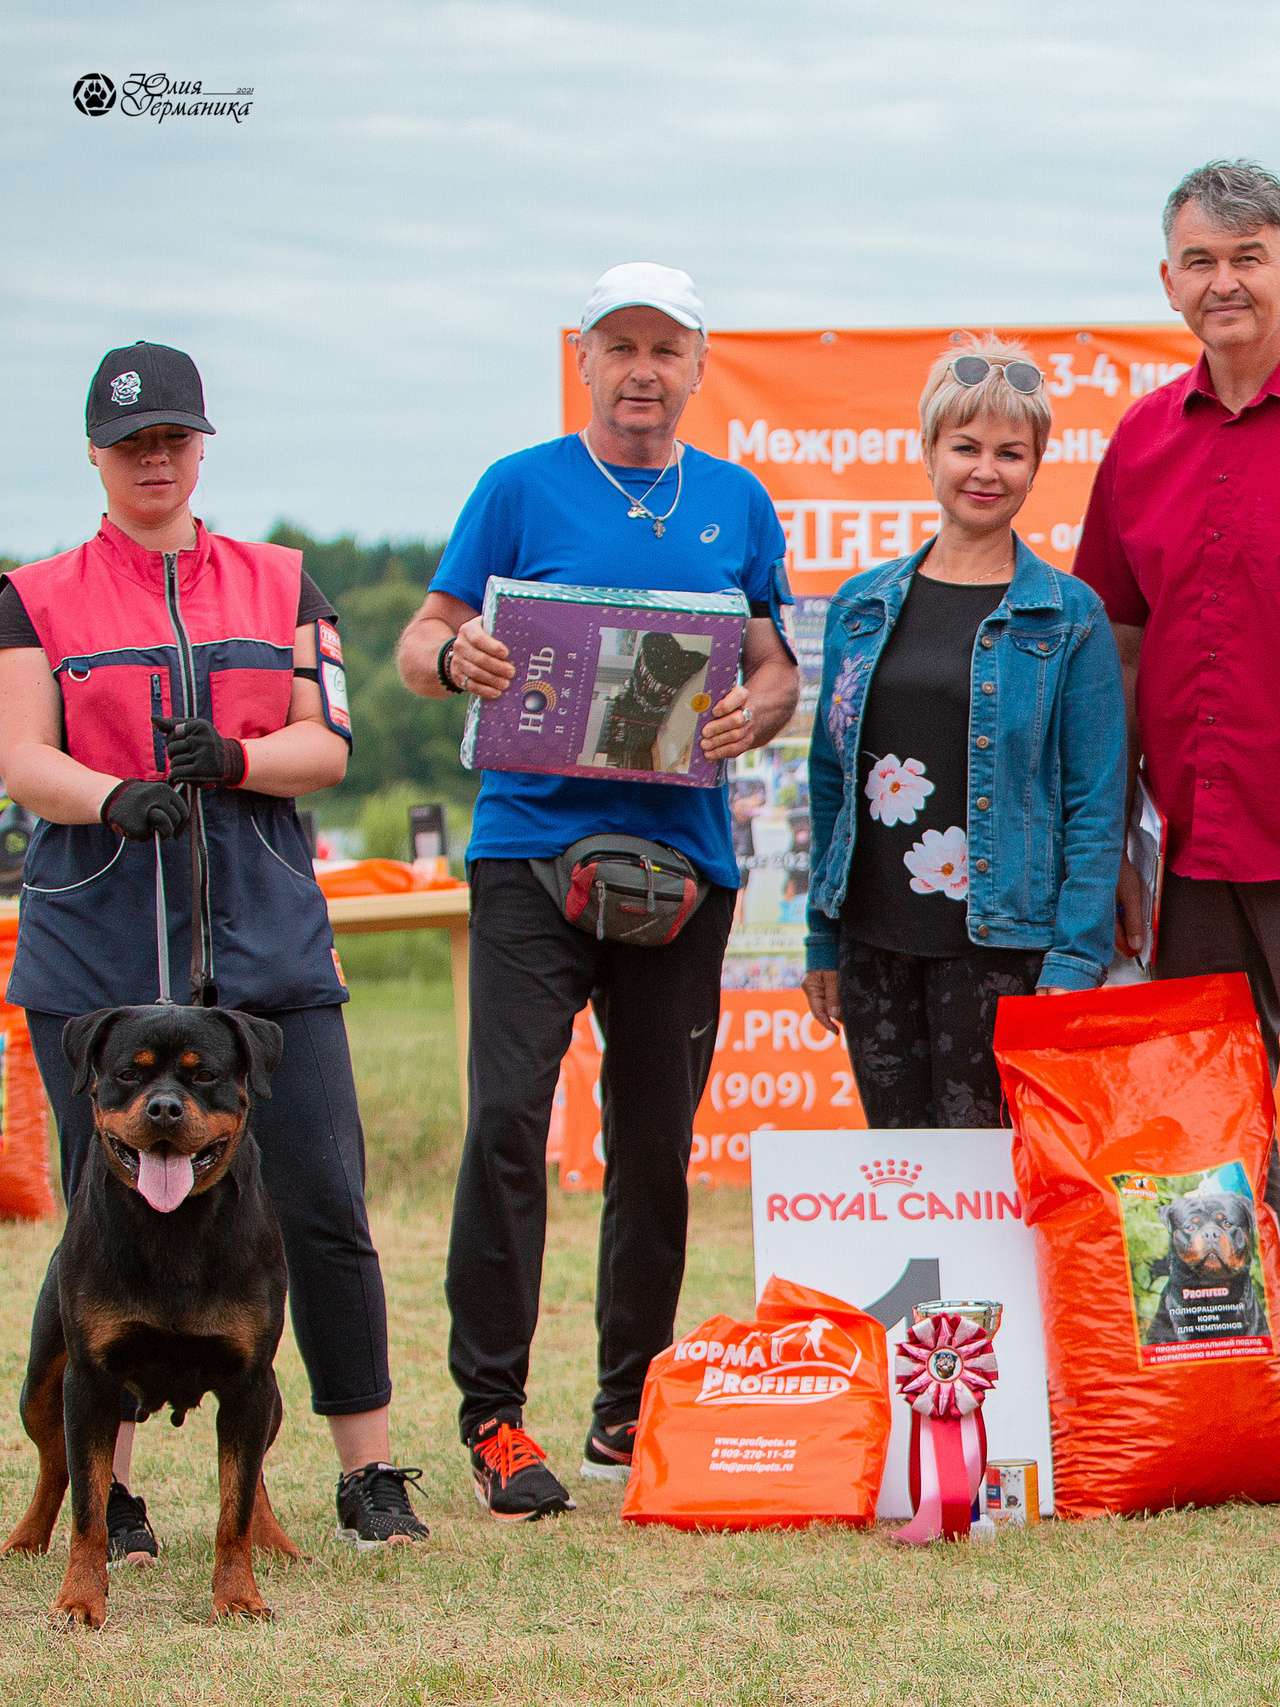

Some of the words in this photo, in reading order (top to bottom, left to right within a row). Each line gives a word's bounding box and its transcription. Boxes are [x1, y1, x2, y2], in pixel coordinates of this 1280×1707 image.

[1049, 353, 1120, 397] 3-4
[710, 1070, 816, 1113] (909)
[829, 1070, 856, 1107] 2
[766, 1192, 888, 1222] ROYAL
[897, 1190, 1022, 1221] CANIN
[1177, 1326, 1194, 1335] ДЛЯ
[1195, 1321, 1243, 1333] ЧЕМПИОНОВ
[1197, 1314, 1219, 1323] КОРМ
[674, 1340, 767, 1370] КОРМА
[702, 1366, 851, 1394] PROFIFEED
[711, 1448, 719, 1459] 8
